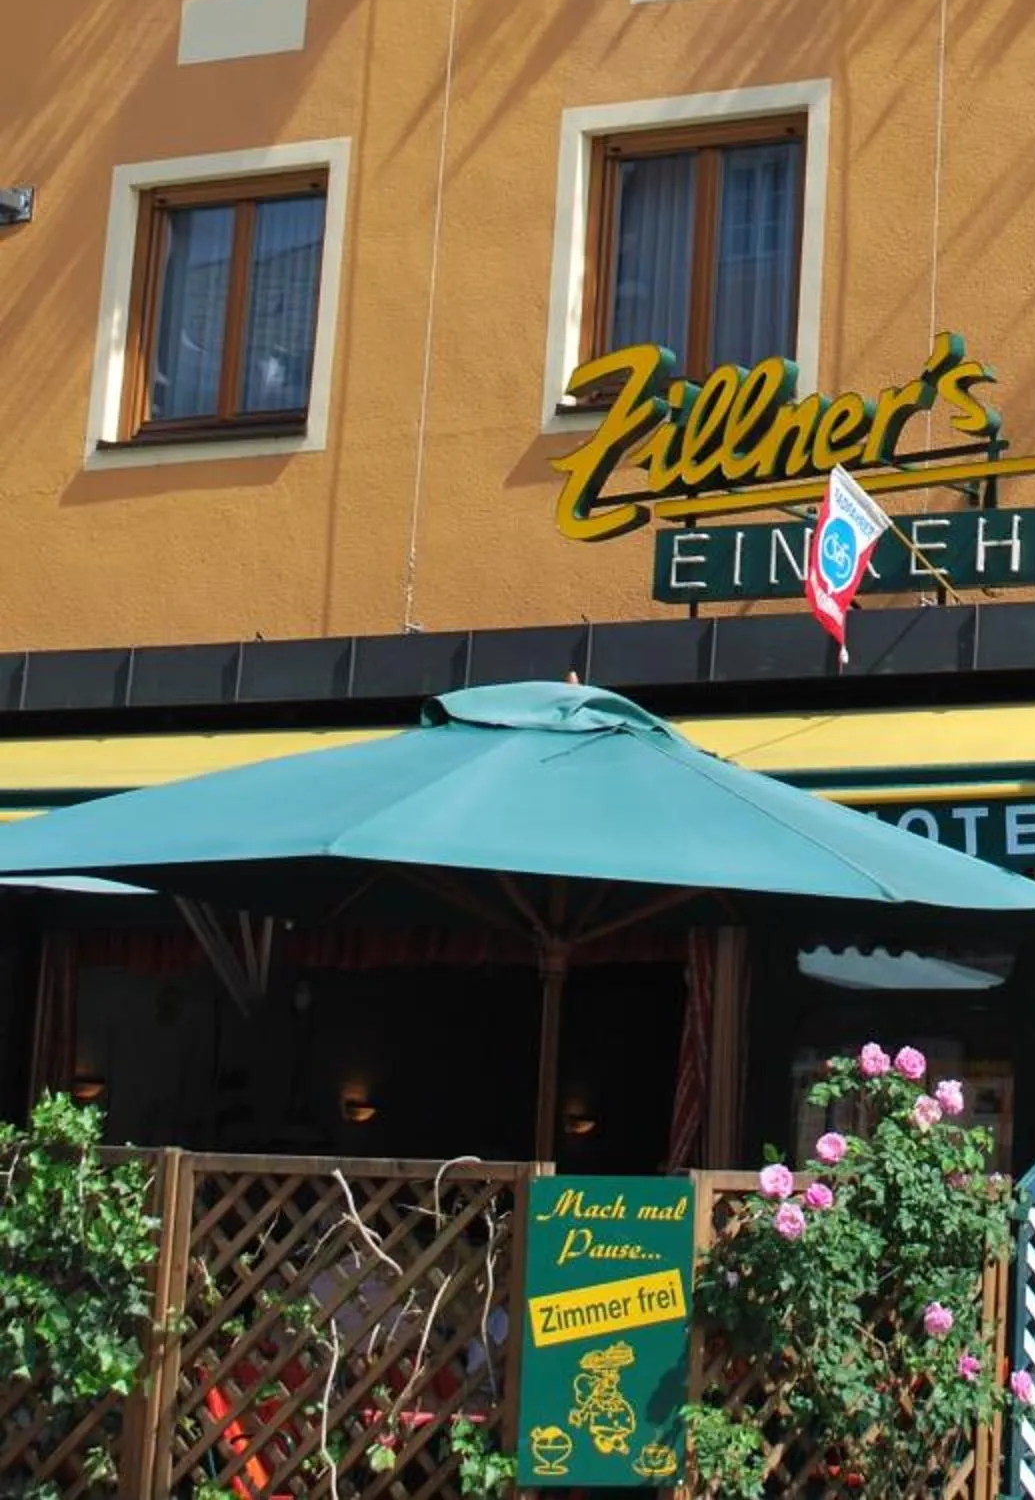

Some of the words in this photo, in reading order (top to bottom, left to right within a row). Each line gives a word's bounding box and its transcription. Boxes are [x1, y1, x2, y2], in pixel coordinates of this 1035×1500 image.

[553, 331, 997, 541] Zillner's
[536, 1188, 627, 1221] Mach
[637, 1196, 688, 1221] mal
[556, 1228, 662, 1266] Pause...
[539, 1297, 632, 1334] Zimmer
[636, 1281, 678, 1314] frei
